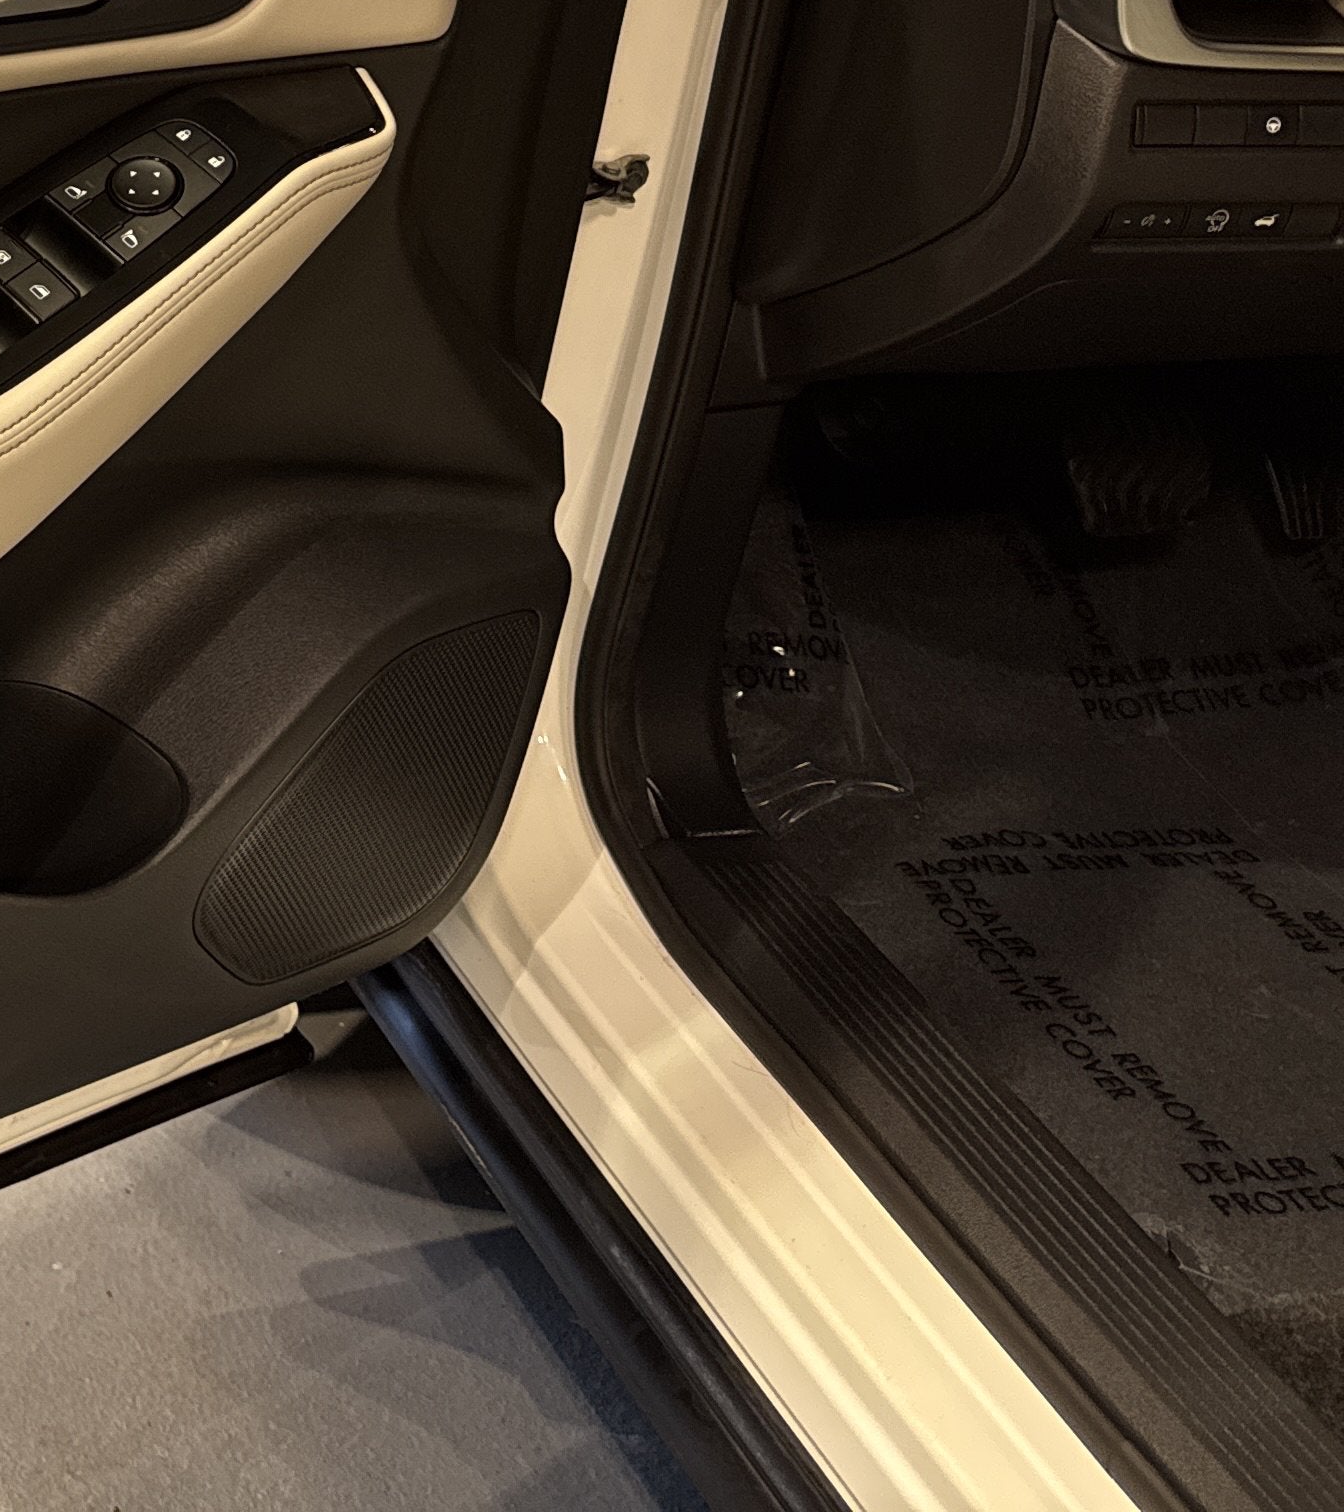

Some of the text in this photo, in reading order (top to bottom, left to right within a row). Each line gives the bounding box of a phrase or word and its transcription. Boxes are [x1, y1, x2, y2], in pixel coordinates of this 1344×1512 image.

[747, 630, 850, 665] REMOV
[1066, 655, 1175, 690] DEALER
[1079, 683, 1252, 722] PROTECTIVE
[941, 826, 1235, 851] PROTECTIVE COVER
[895, 848, 1261, 878] DEALER MUST REMOVE
[1213, 869, 1329, 953] REMOVE
[914, 878, 1138, 1102] PROTECTIVE COVER
[948, 876, 1234, 1155] DEALER MUST REMOVE
[1178, 1155, 1319, 1185] DEALER
[1207, 1182, 1344, 1218] PROTEC
